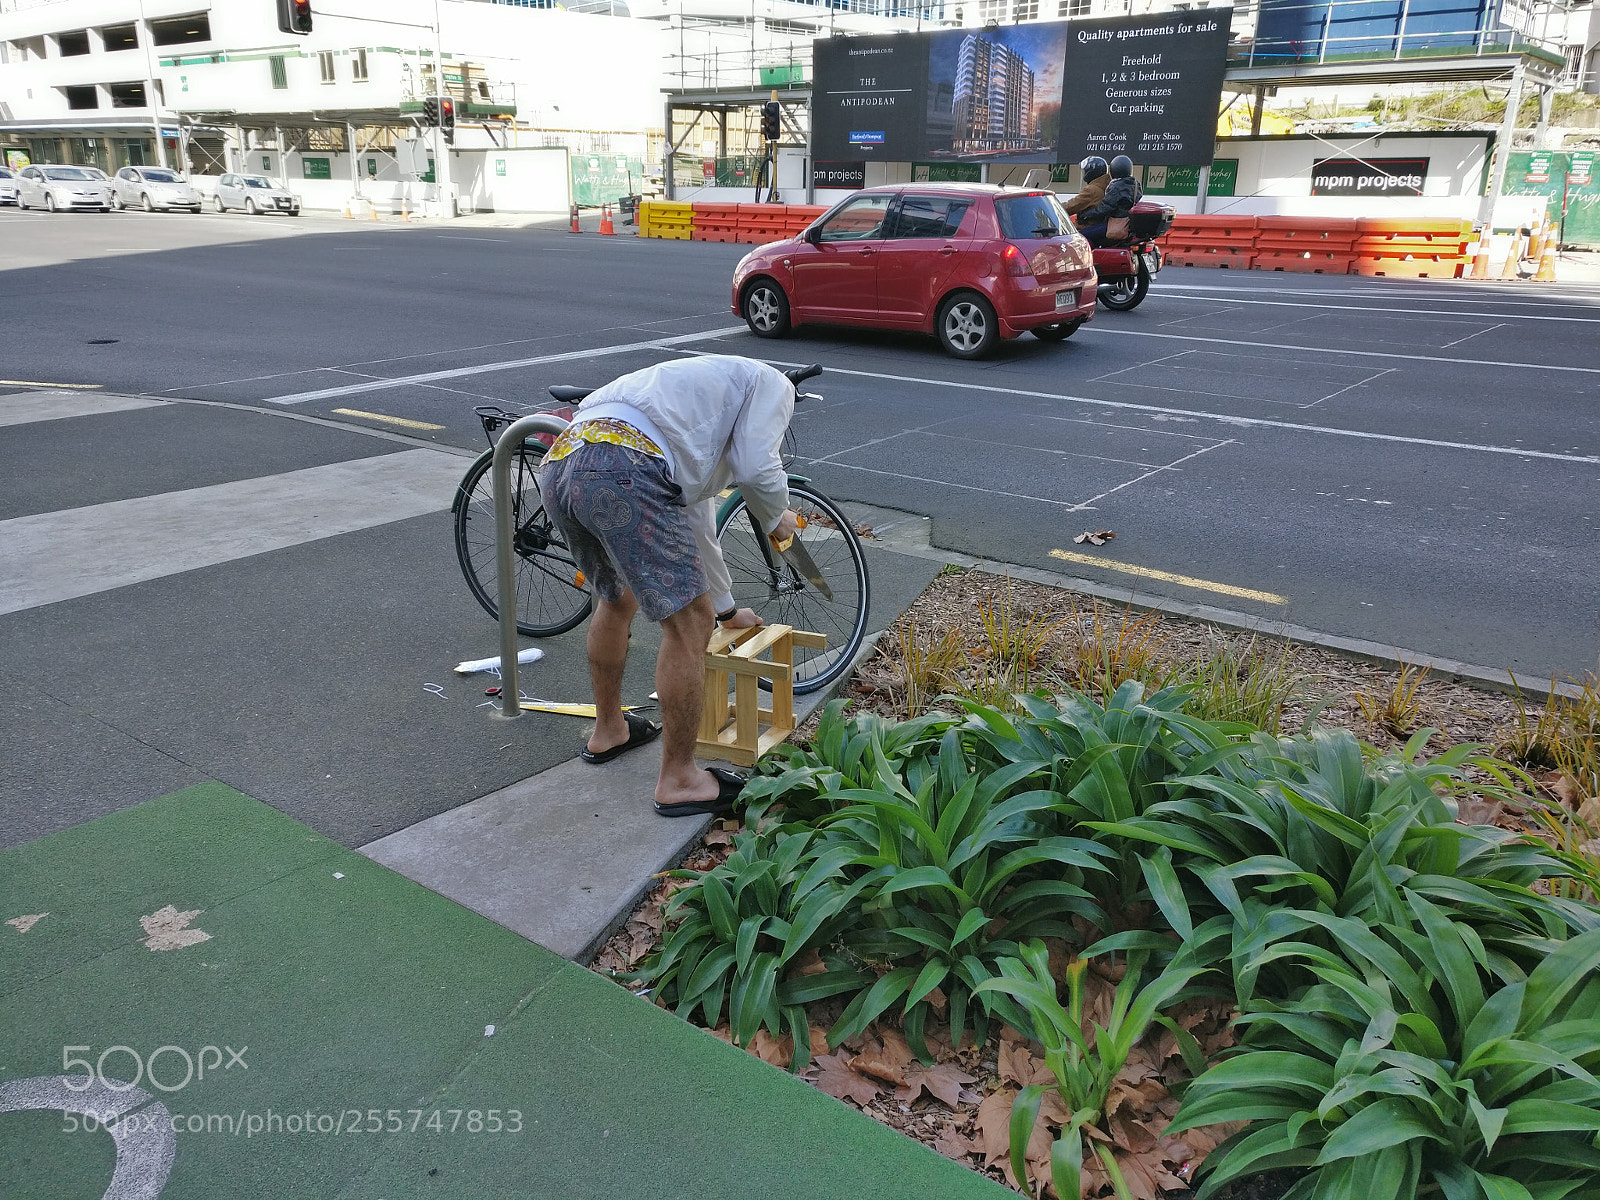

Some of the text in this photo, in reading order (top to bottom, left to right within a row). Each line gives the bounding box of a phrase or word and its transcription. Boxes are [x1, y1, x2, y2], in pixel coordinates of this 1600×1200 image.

[1077, 20, 1218, 43] Quality apartments for sale
[1122, 54, 1162, 66] Freehold
[860, 77, 877, 86] THE
[1101, 70, 1180, 84] 1, 2 & 3 bedroom
[1105, 86, 1172, 98] Generous sizes
[840, 97, 896, 107] ANTIPODEAN
[1109, 102, 1164, 115] Car parking
[1086, 132, 1127, 141] Aaron Cook
[1142, 131, 1180, 142] Betty Shao
[1086, 143, 1098, 151] 021
[1113, 143, 1125, 151] 642
[1138, 143, 1183, 151] 021 215 1570
[828, 169, 863, 182] projects
[1149, 171, 1165, 183] WH
[1167, 168, 1192, 179] Watts
[1208, 168, 1232, 181] ughes
[1314, 173, 1422, 190] mpm projects
